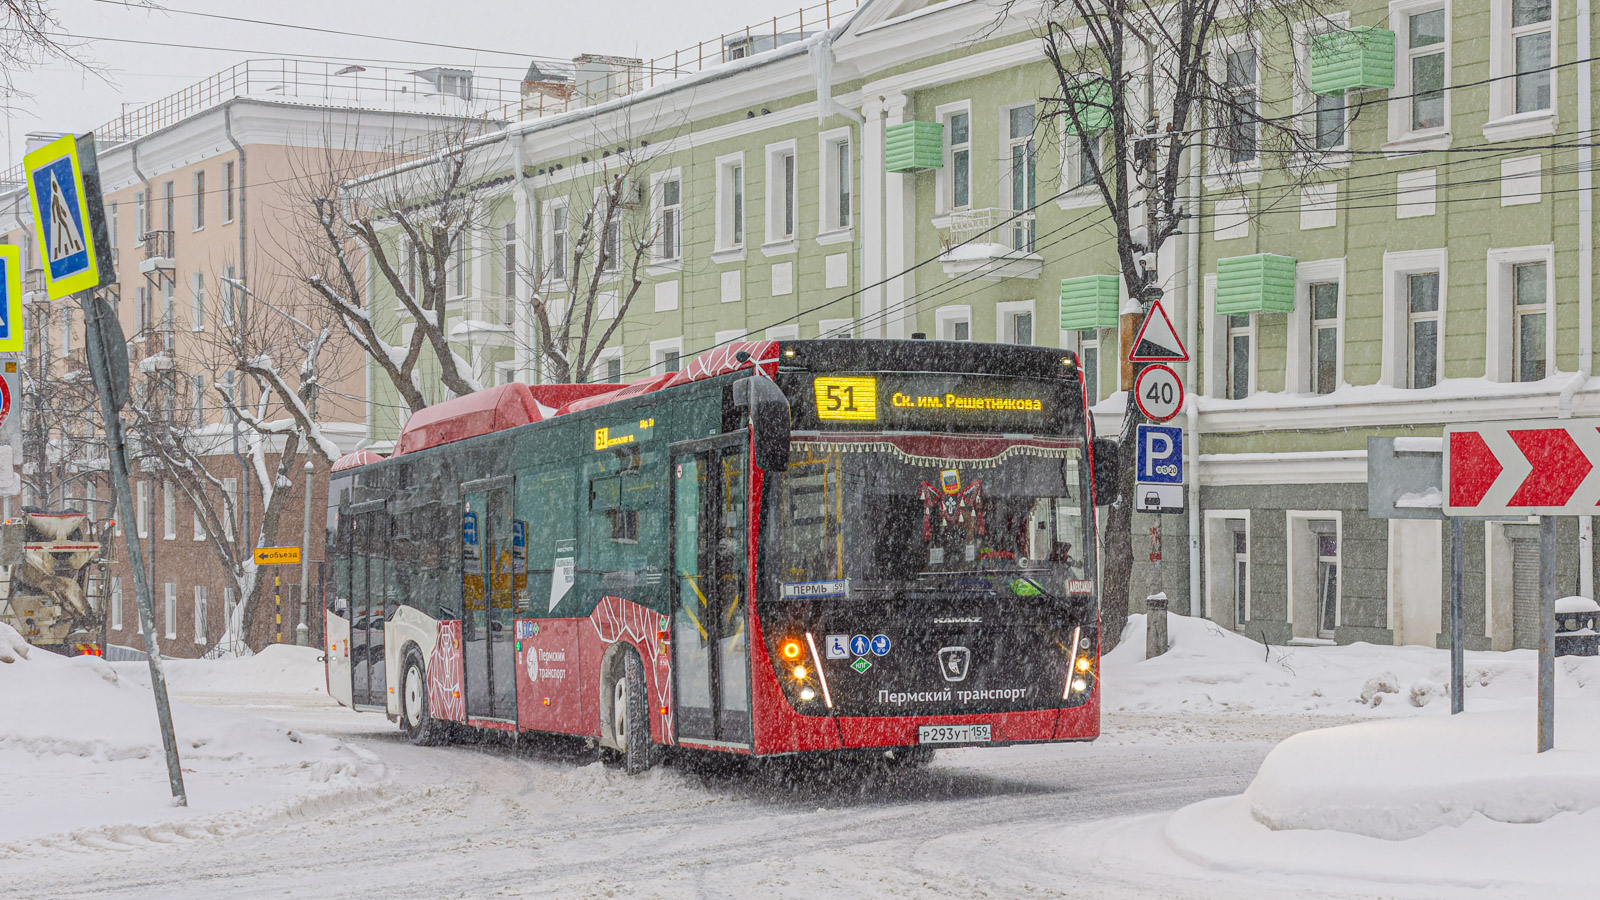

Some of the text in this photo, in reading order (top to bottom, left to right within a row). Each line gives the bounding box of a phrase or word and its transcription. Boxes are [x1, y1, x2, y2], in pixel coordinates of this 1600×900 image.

[827, 385, 858, 412] 51
[892, 393, 1042, 411] Ск. им. Решетникова
[1146, 382, 1173, 404] 40
[1169, 466, 1176, 474] 20
[793, 585, 827, 595] ПЕРМЬ
[538, 648, 566, 666] Пермский
[538, 668, 567, 683] транспорт
[878, 688, 1027, 706] Пермский транспорт
[923, 726, 988, 741] Р293УТ 159
